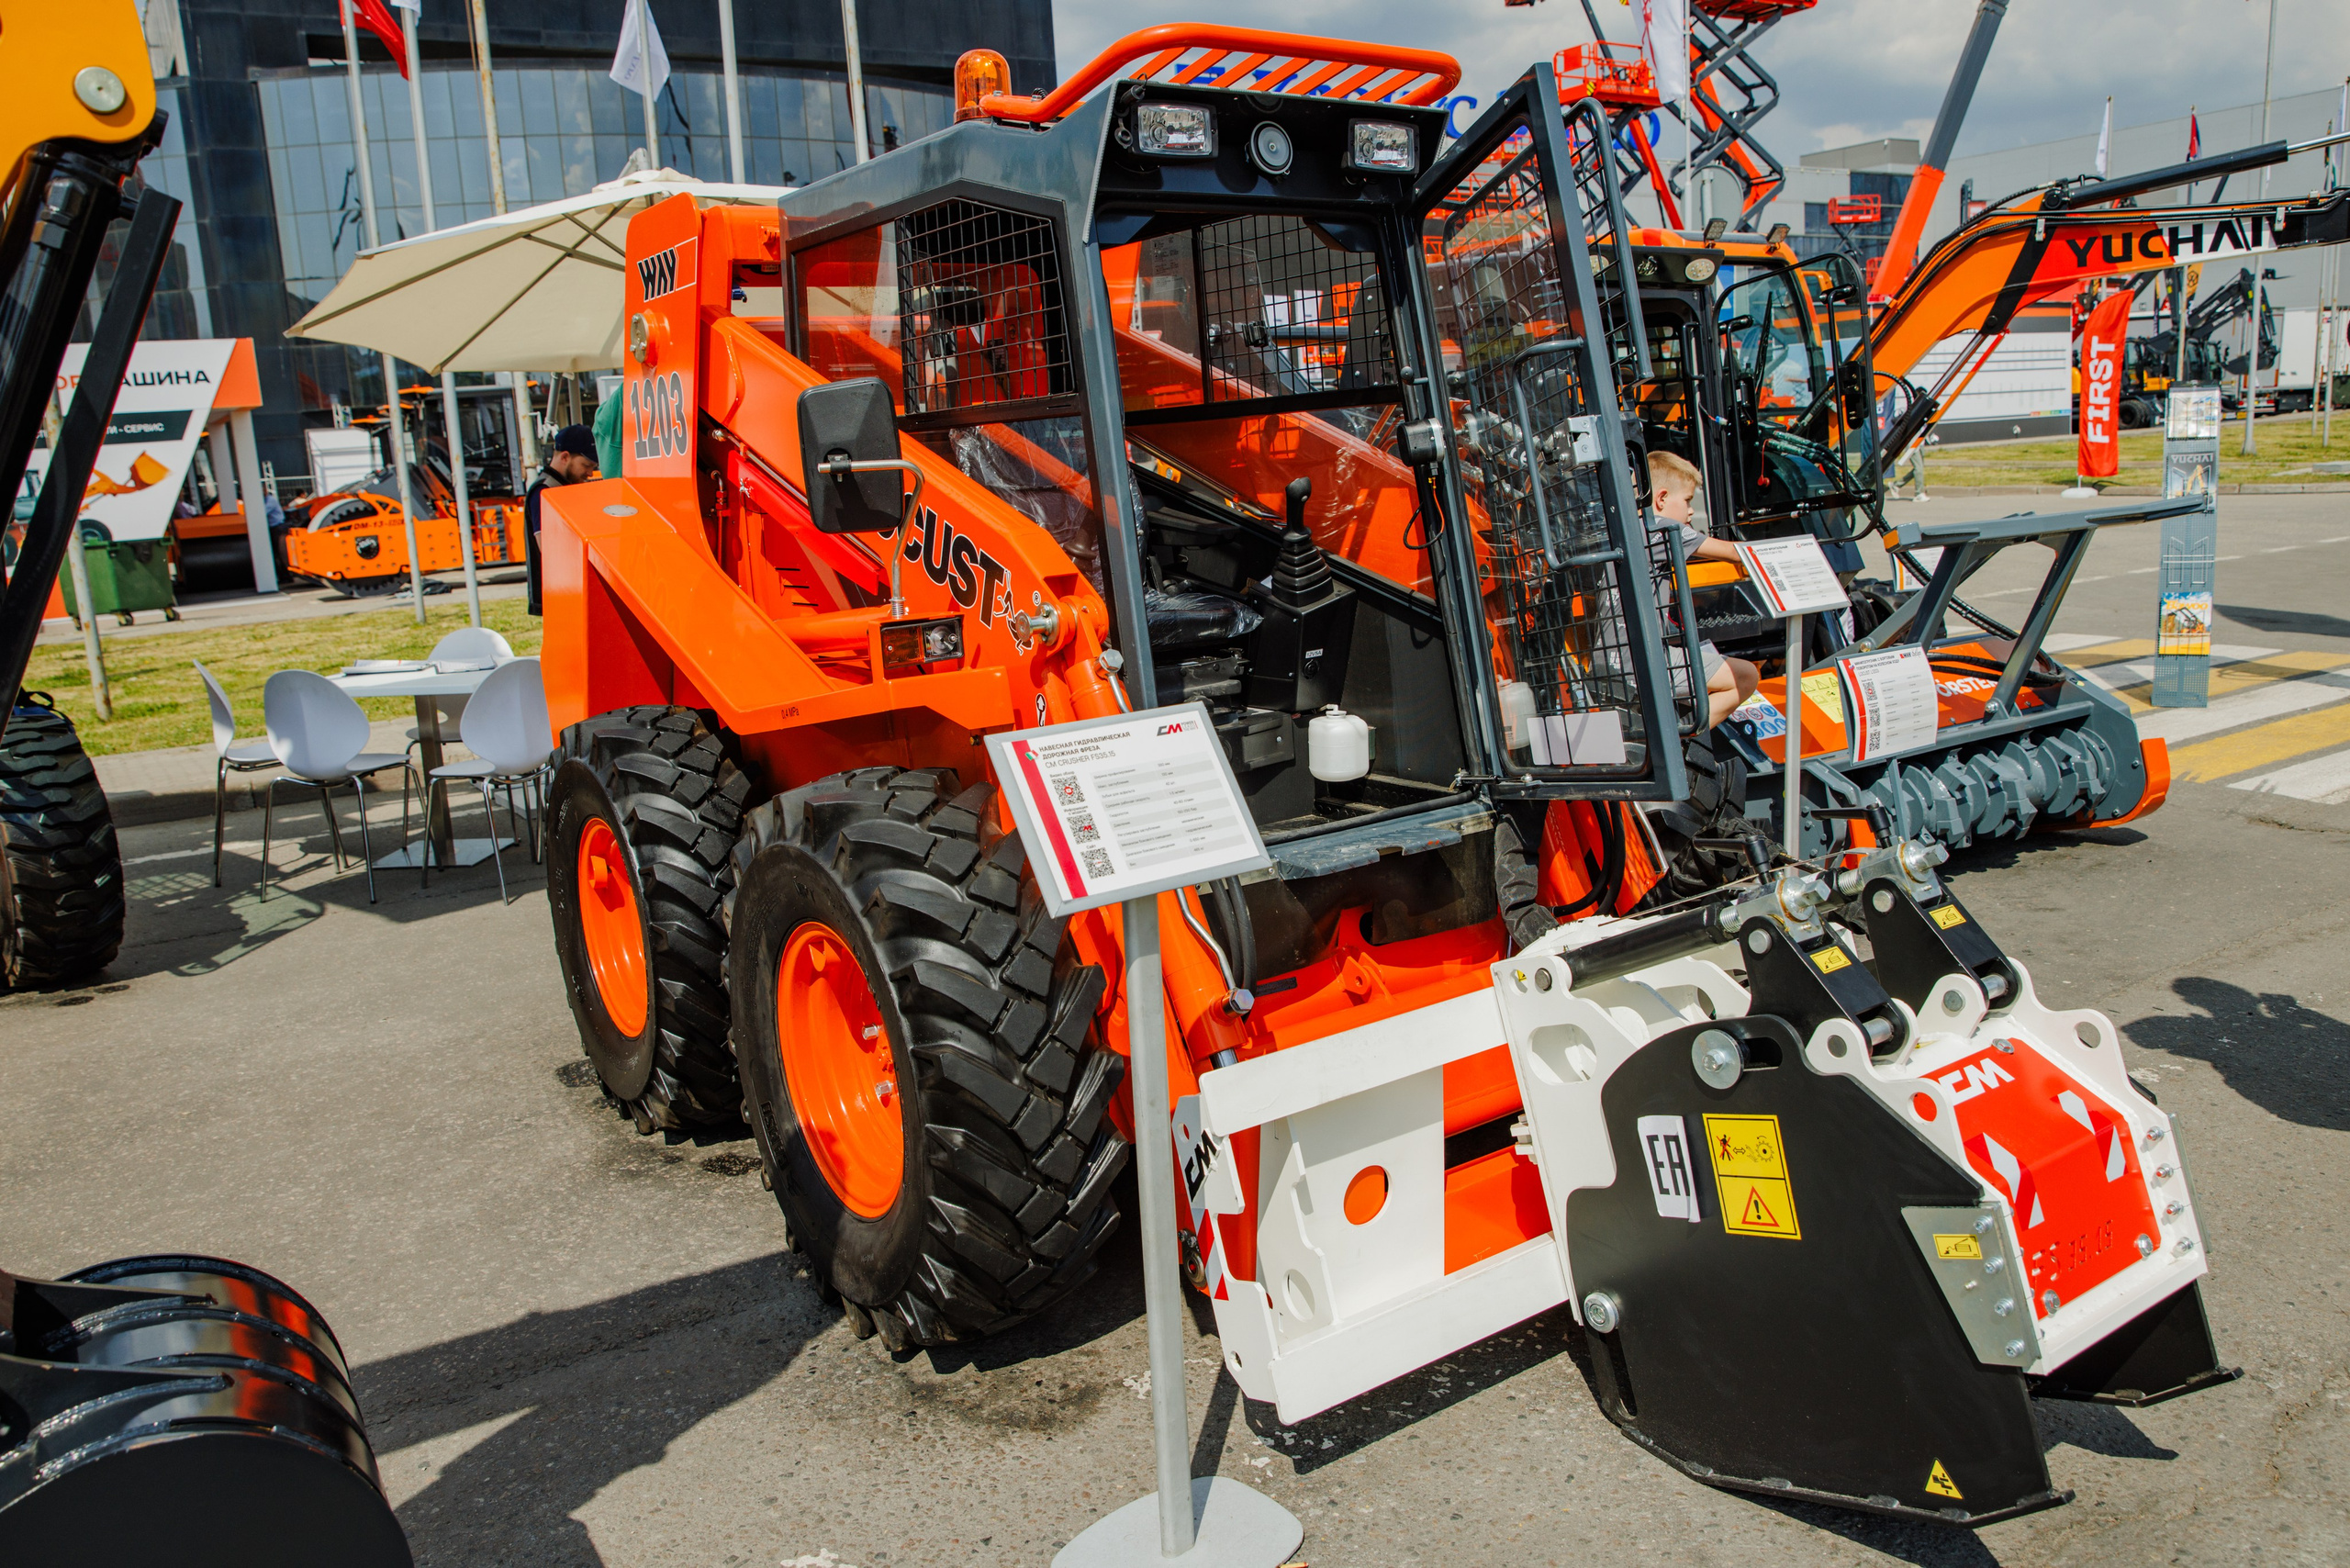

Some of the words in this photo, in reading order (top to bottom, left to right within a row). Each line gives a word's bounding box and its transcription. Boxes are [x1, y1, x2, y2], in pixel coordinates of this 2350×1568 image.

[637, 248, 677, 303] WAY
[2087, 336, 2115, 443] FIRST
[125, 422, 165, 433] СЕРВИС
[630, 371, 688, 460] 1203
[2171, 454, 2213, 465] YUCHAI
[878, 492, 1006, 630] CUST
[1038, 741, 1073, 751] НАВЕСНАЯ
[1072, 731, 1130, 745] ГИДРАВЛИЧЕСКАЯ
[1157, 722, 1183, 736] CM
[1041, 748, 1080, 759] ДОРОЖНАЯ
[1079, 745, 1100, 753] ФРЕЗА
[1044, 760, 1057, 768] CM
[1057, 755, 1090, 766] CRUSHER
[1090, 750, 1116, 760] FS35.15
[1938, 1058, 2016, 1107] CM
[1184, 1129, 1220, 1203] CM
